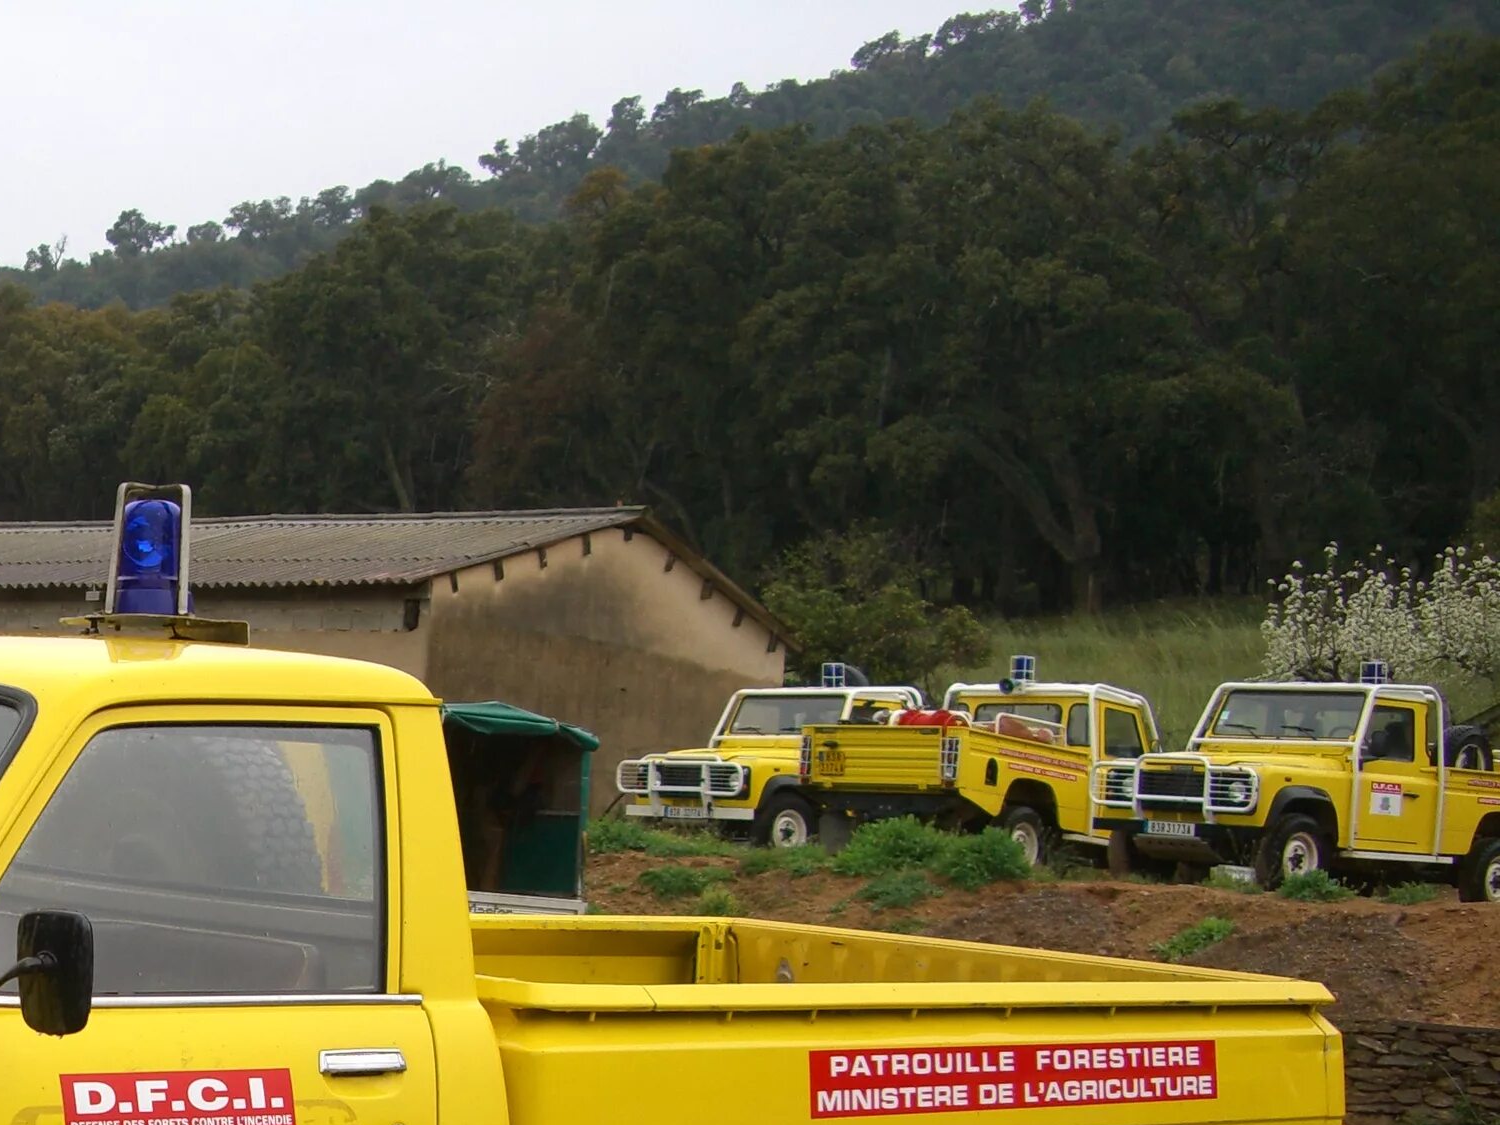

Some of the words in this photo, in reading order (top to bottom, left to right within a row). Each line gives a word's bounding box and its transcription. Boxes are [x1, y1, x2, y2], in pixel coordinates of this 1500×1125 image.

[830, 1051, 1015, 1078] PATROUILLE
[1036, 1046, 1200, 1071] FORESTIERE
[73, 1077, 284, 1115] D.F.C.I.
[817, 1085, 968, 1112] MINISTERE
[979, 1083, 1014, 1105] DE
[1024, 1075, 1212, 1103] L'AGRICULTURE
